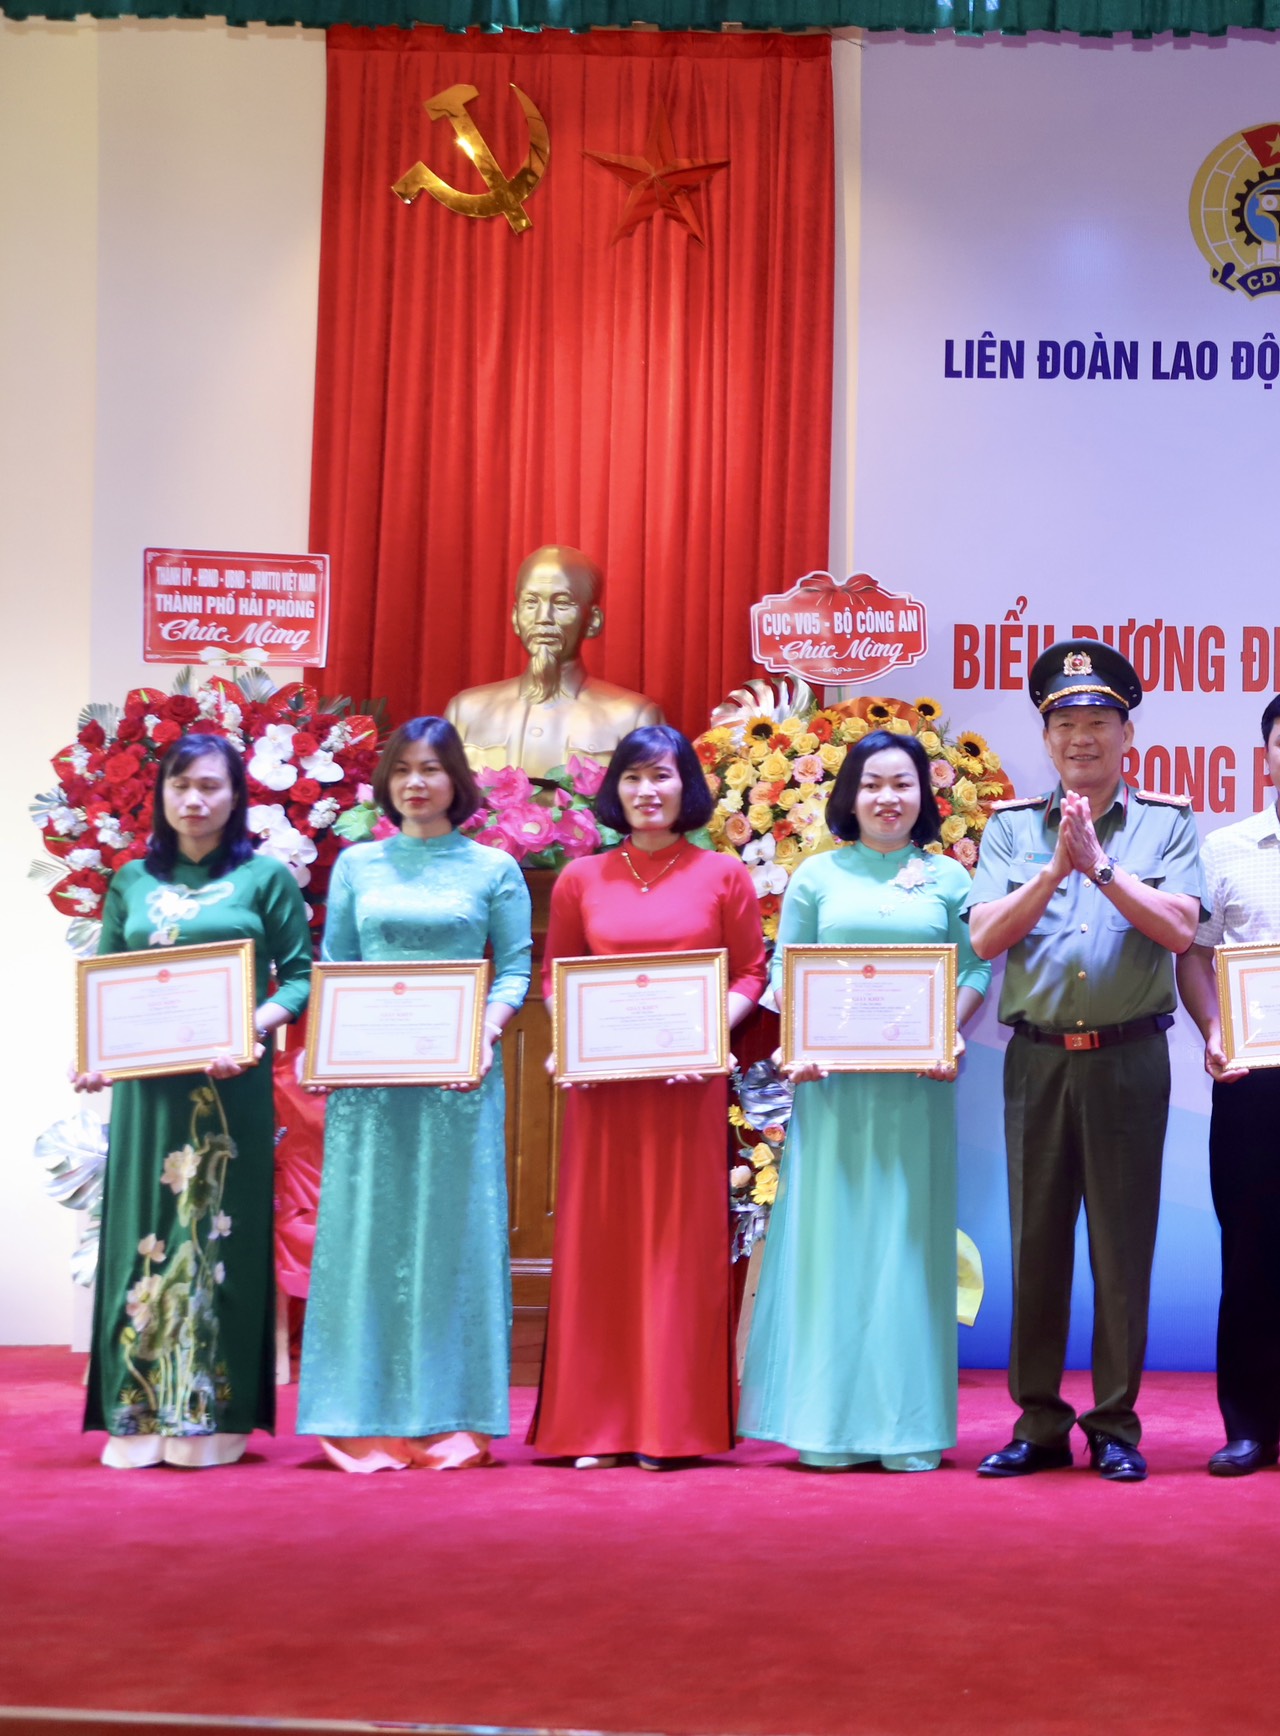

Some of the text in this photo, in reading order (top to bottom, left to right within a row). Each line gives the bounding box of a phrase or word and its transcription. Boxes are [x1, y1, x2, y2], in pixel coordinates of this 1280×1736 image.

[944, 331, 1025, 379] LIÊN
[1036, 331, 1139, 380] ĐOÀN
[1152, 340, 1219, 381] LAO
[155, 590, 315, 619] THÀNH PHỐ HẢI PHÒNG
[158, 618, 311, 651] Chúc Mừng
[762, 612, 792, 641] CỤC
[833, 606, 853, 639] BỘ
[856, 606, 895, 634] CÔNG
[898, 609, 919, 633] AN
[779, 637, 904, 664] Chúc Mừng
